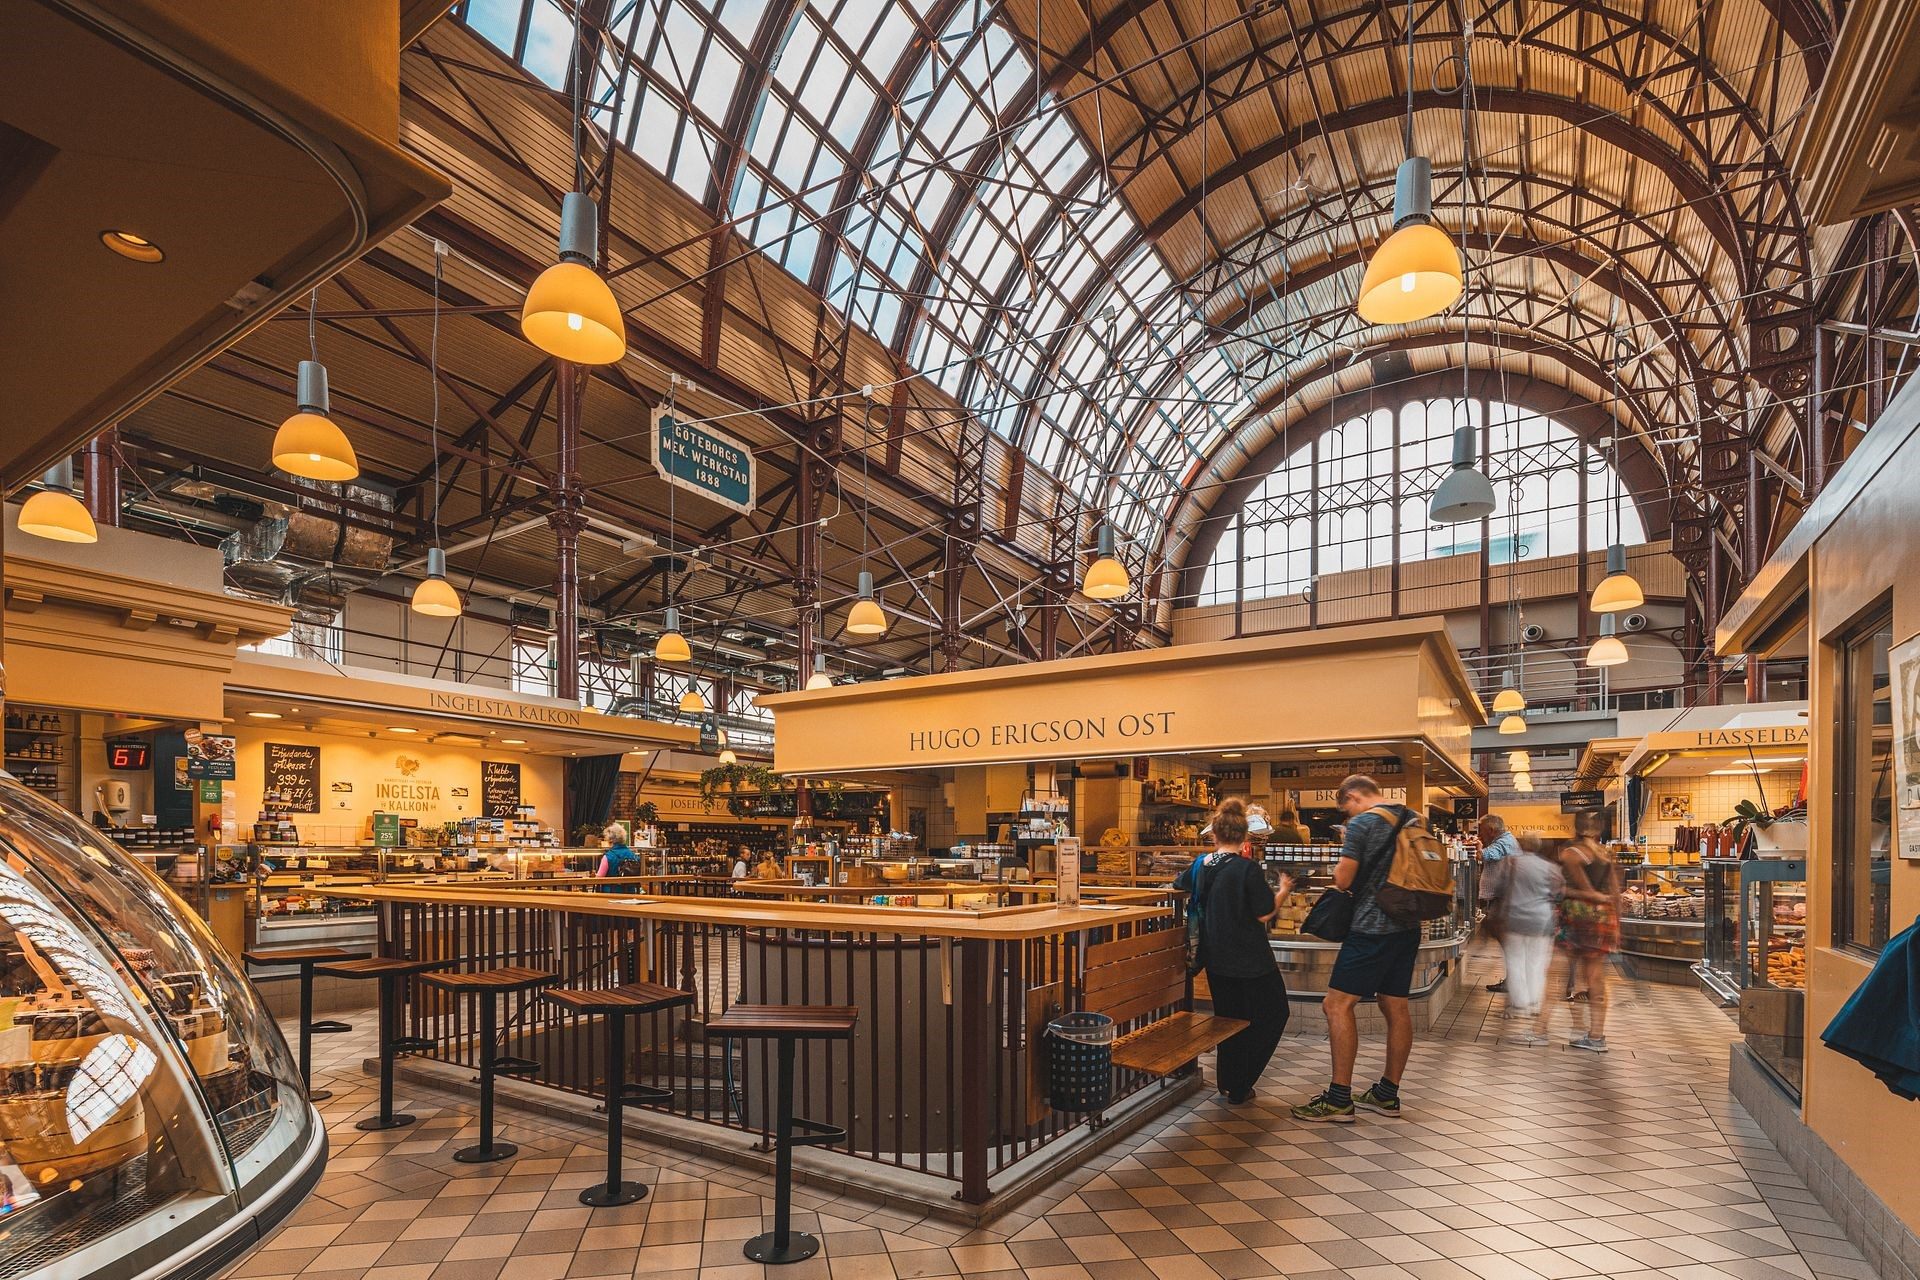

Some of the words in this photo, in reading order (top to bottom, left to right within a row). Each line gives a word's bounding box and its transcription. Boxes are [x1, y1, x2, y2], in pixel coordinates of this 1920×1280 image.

[675, 425, 738, 464] GÖTEBORGS
[662, 436, 689, 459] MEK.
[691, 449, 748, 485] WERKSTAD
[695, 468, 720, 488] 1888
[430, 692, 513, 717] INGELSTA
[519, 705, 581, 726] KALKON
[910, 727, 981, 752] HUGO
[991, 717, 1106, 746] ERICSON
[1118, 711, 1176, 737] OST
[114, 749, 145, 766] 61
[276, 774, 298, 786] 399
[376, 783, 440, 800] INGELSTA
[389, 800, 429, 812] KALKON
[492, 805, 514, 817] 25%
[380, 832, 394, 840] 25%
[1521, 824, 1545, 832] YOUR
[1547, 823, 1571, 832] BODY
